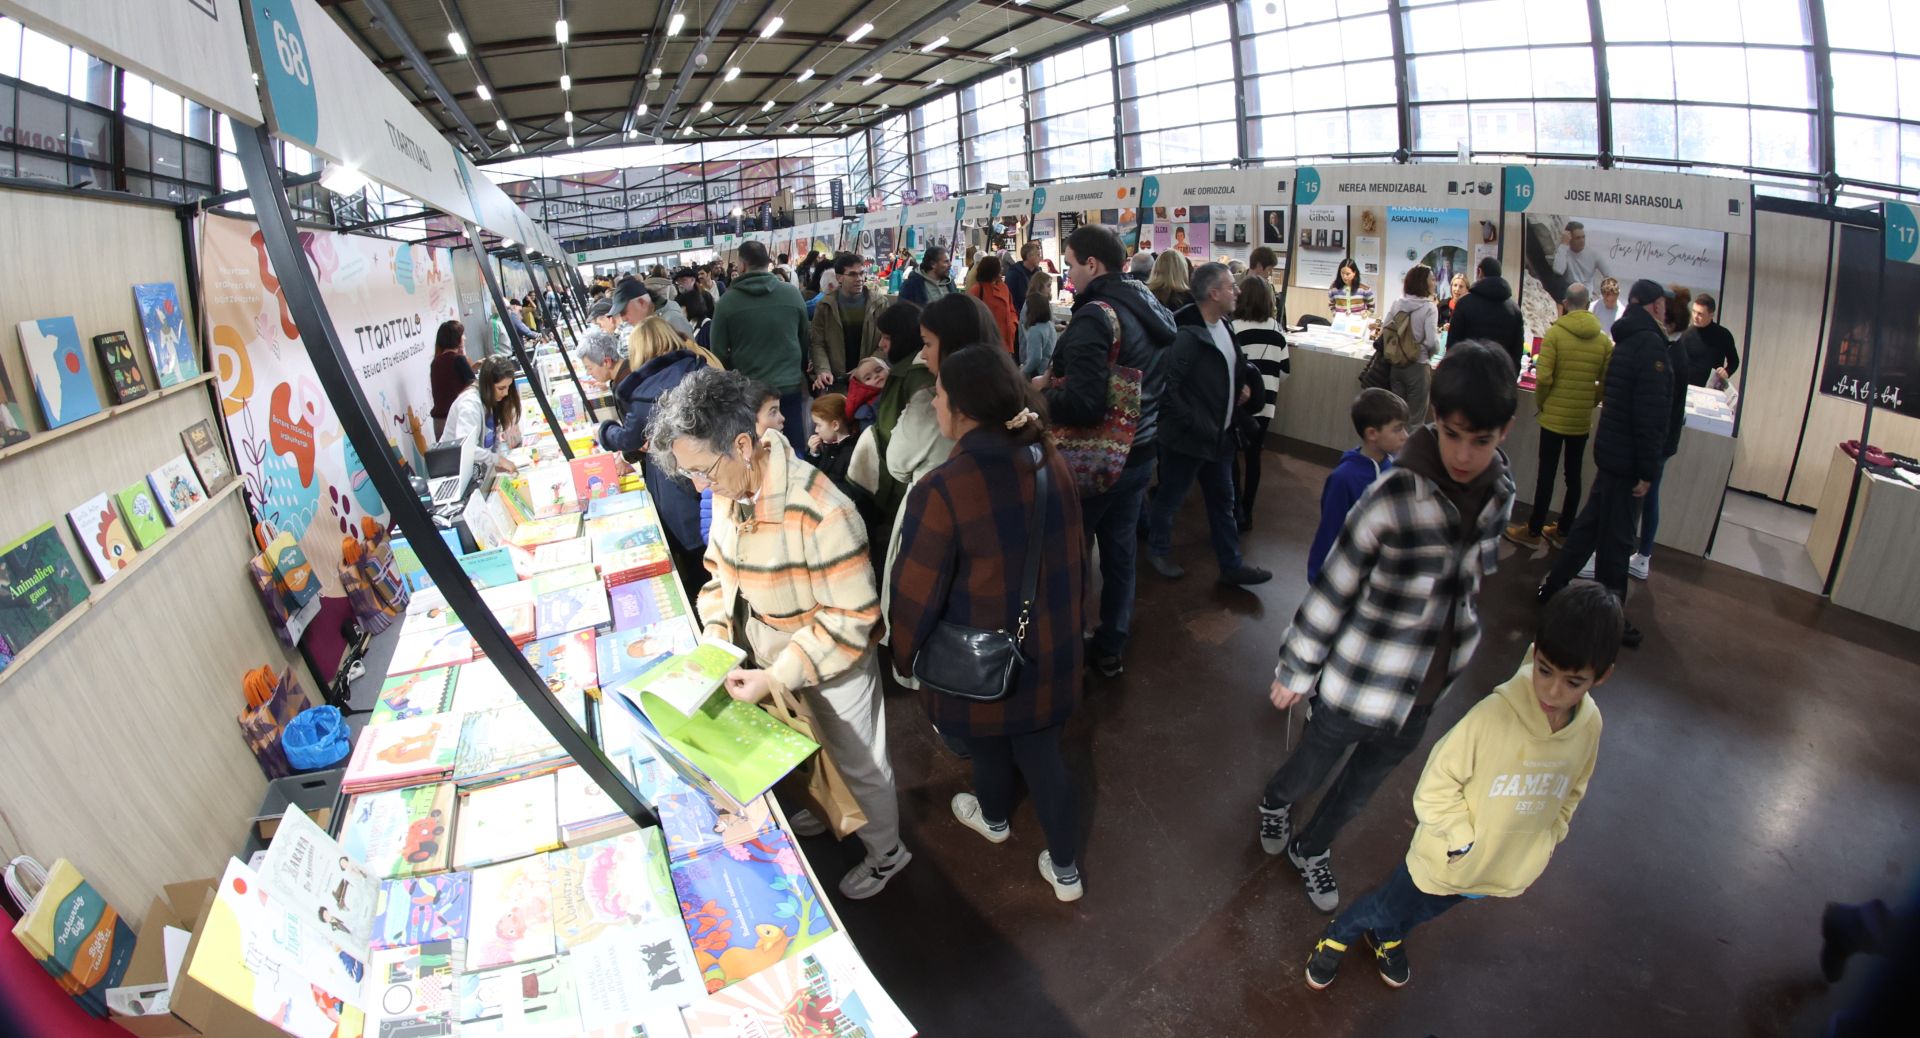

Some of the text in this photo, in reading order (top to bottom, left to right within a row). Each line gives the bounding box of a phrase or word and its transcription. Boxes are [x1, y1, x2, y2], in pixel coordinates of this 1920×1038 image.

[272, 20, 309, 86] 68
[384, 118, 432, 172] TTARTTALO
[1059, 194, 1074, 202] ELENA
[1074, 192, 1104, 201] FERNANDEZ
[1148, 186, 1235, 197] 14 ANE ODRIOZOLA
[1305, 182, 1428, 193] 15 NEREA MENDIZABAL
[1514, 184, 1683, 210] 16 JOSE MARI SARASOLA
[1309, 213, 1335, 223] Gibola
[1391, 215, 1439, 224] ASKATU NAHI?
[1898, 227, 1915, 244] 17
[354, 312, 422, 355] TTARTTALO
[9, 564, 55, 600] Animalien
[29, 585, 48, 605] gaua
[1488, 772, 1553, 798] GAME
[58, 895, 85, 945] Irakurriz
